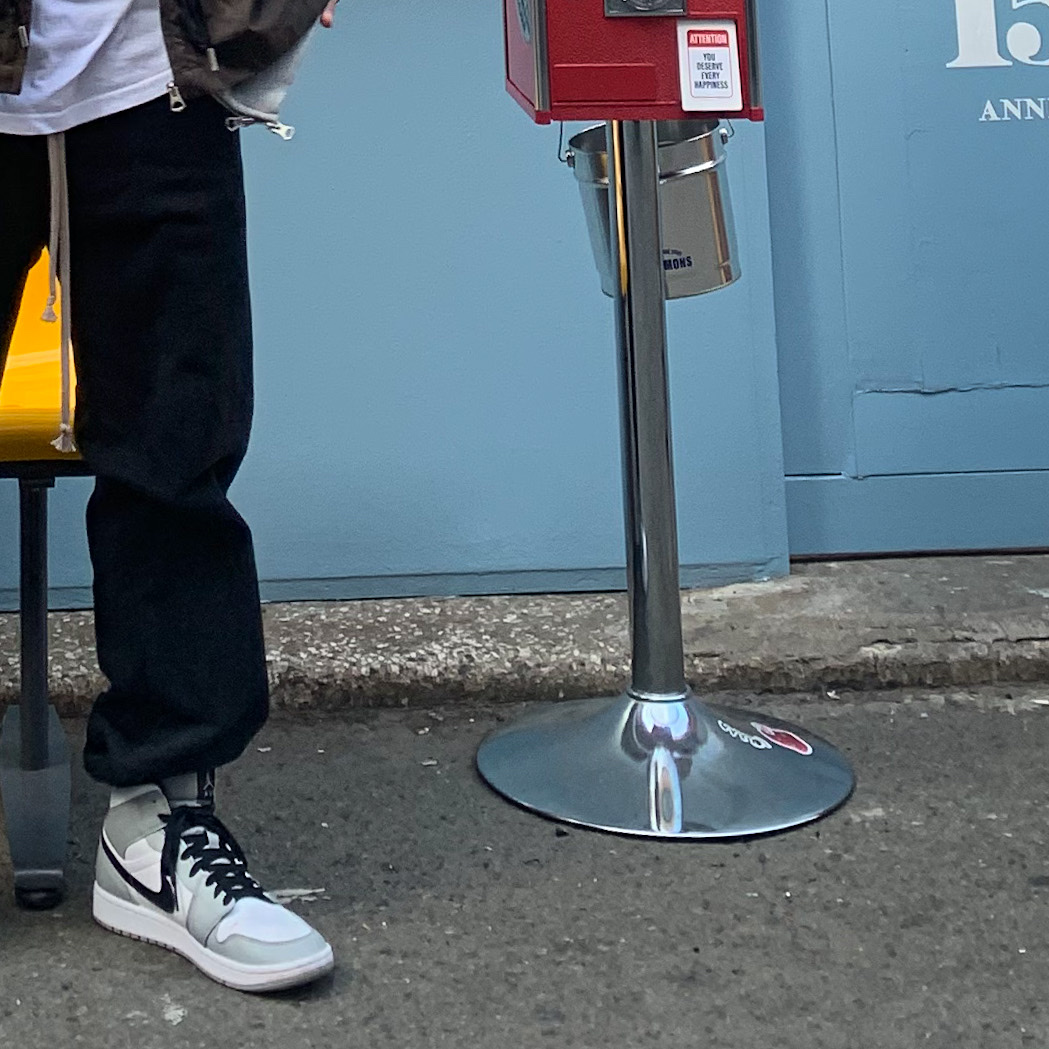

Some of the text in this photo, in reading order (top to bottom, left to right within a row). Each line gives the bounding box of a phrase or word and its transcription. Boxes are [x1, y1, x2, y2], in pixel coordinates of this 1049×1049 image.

[690, 33, 728, 44] ATTENTION
[703, 53, 716, 61] YOU
[696, 62, 723, 71] DESERVE
[701, 71, 720, 80] EVERY
[694, 81, 729, 89] HAPPINESS
